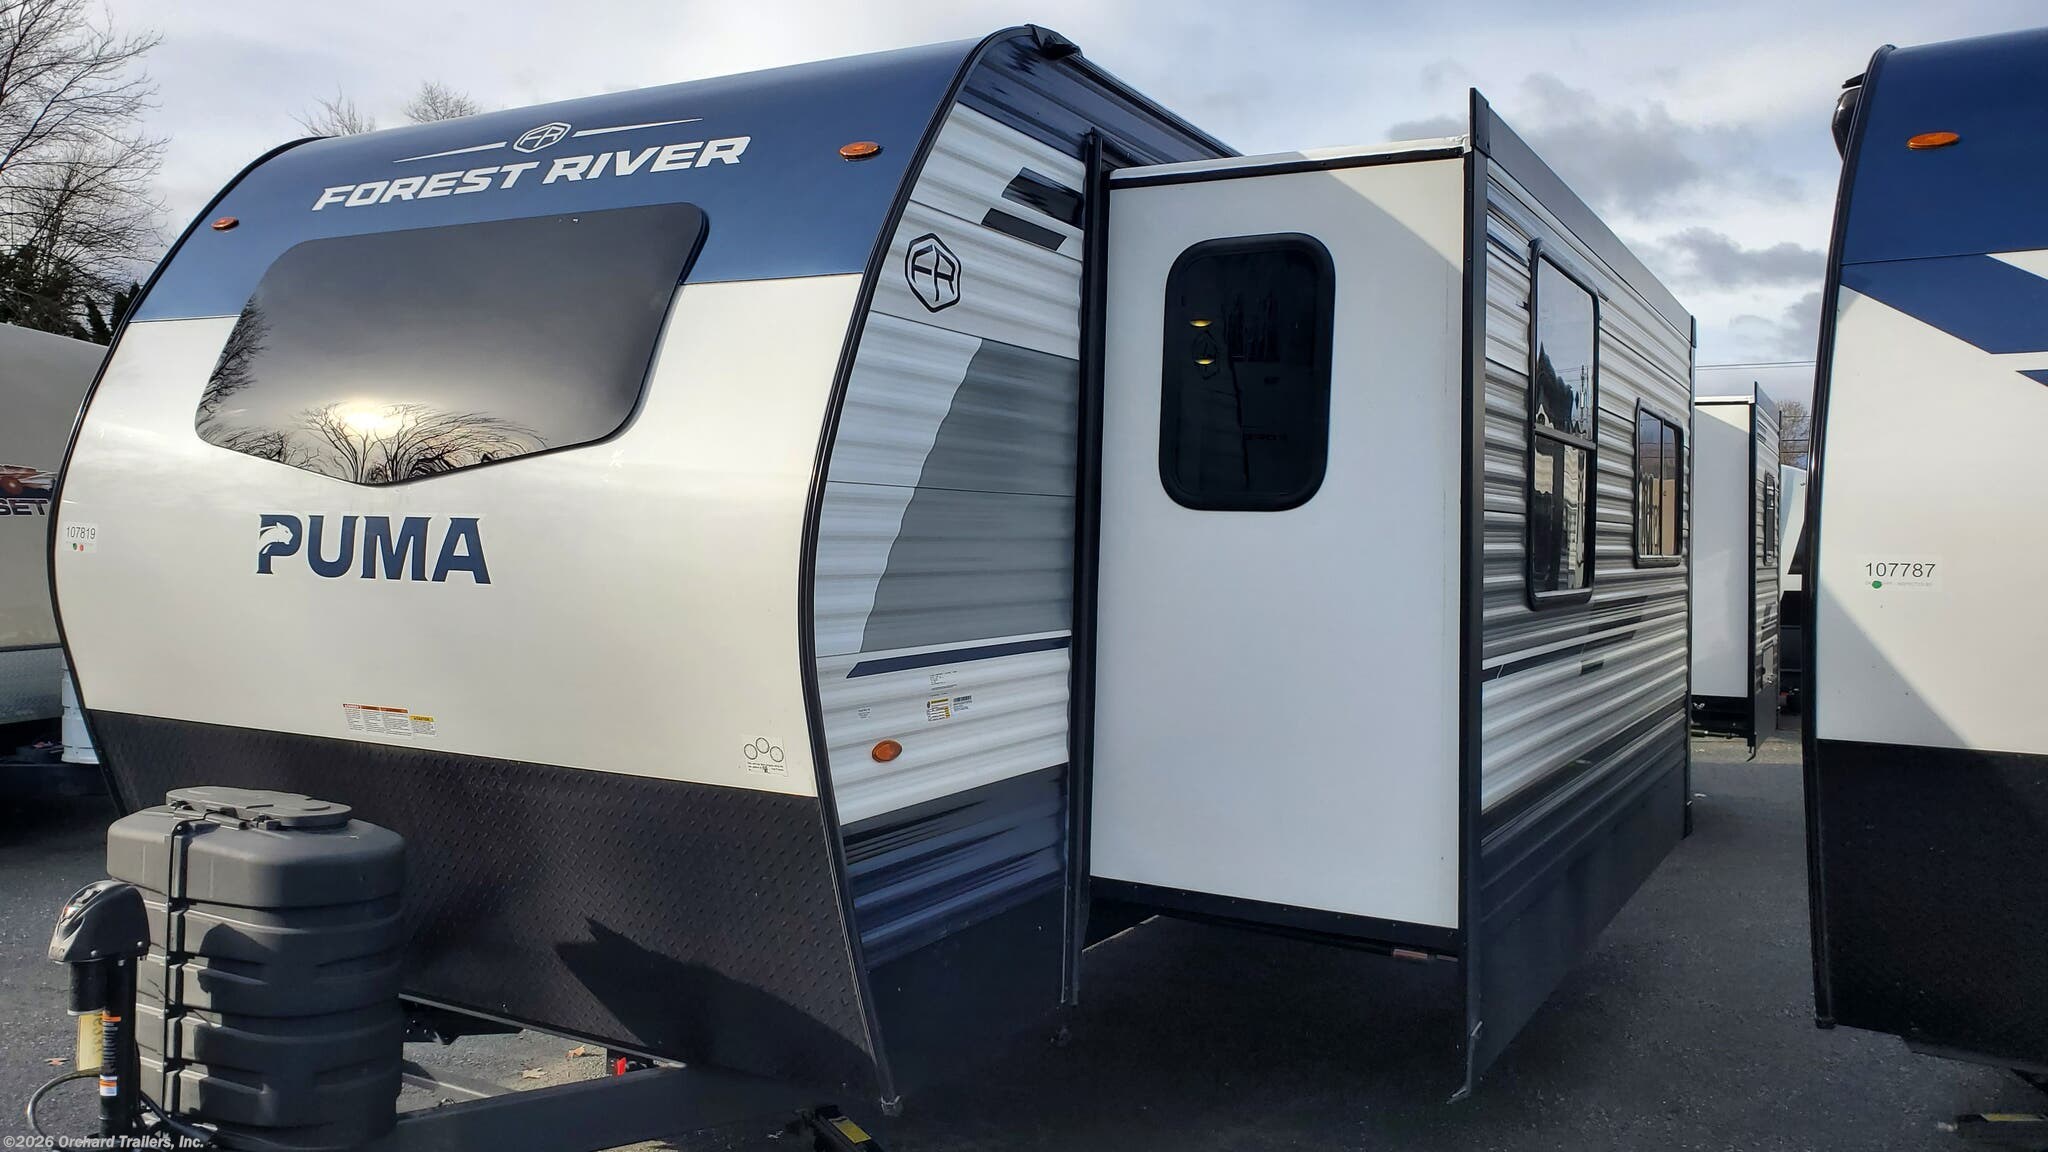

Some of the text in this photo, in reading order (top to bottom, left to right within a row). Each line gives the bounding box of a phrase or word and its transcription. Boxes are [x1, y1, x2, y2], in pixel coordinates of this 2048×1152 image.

[311, 135, 752, 211] FOREST RIVER
[66, 527, 96, 540] 107819
[256, 514, 492, 585] PUMA
[1865, 562, 1936, 578] 107787
